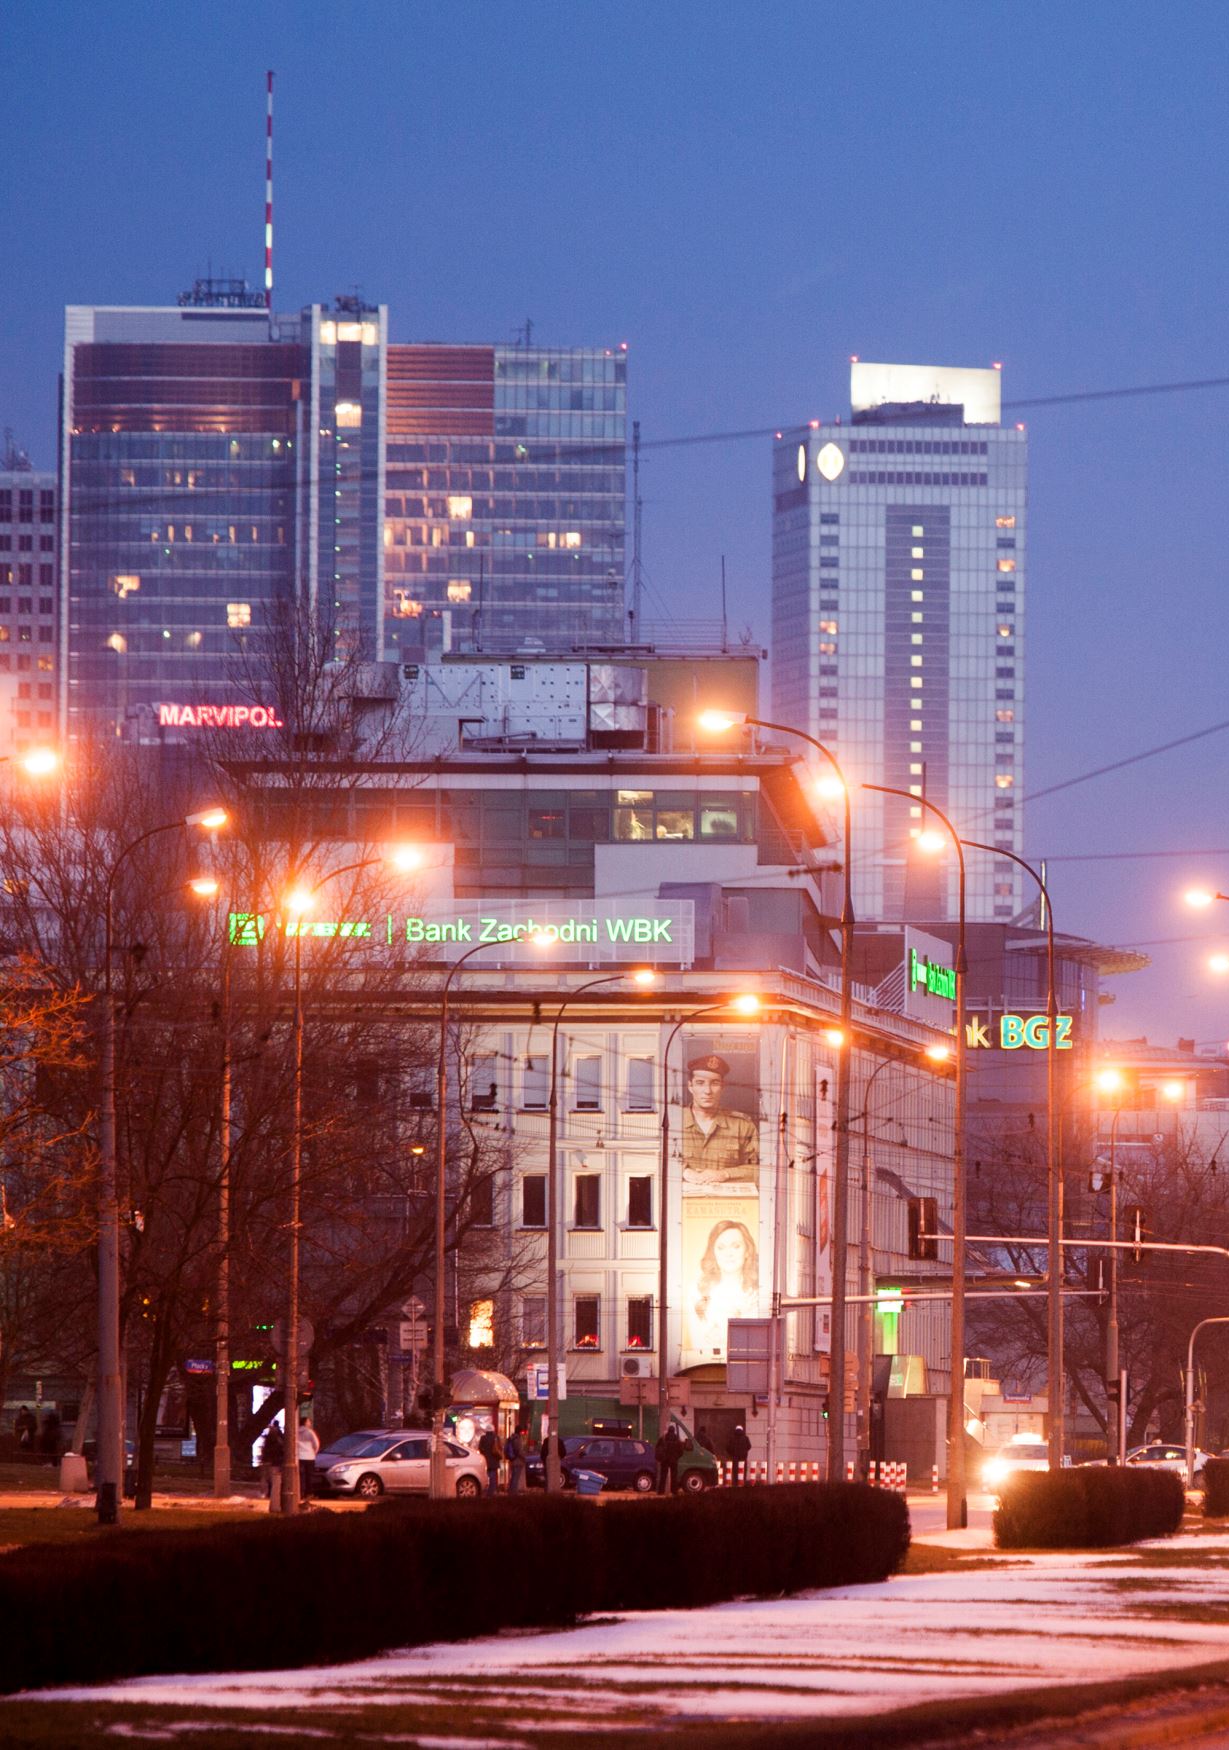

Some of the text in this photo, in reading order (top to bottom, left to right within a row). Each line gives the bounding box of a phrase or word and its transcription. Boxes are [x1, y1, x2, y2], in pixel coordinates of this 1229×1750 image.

[159, 704, 283, 728] MARVIPOL
[406, 918, 471, 942] Bank
[606, 919, 673, 942] WBK
